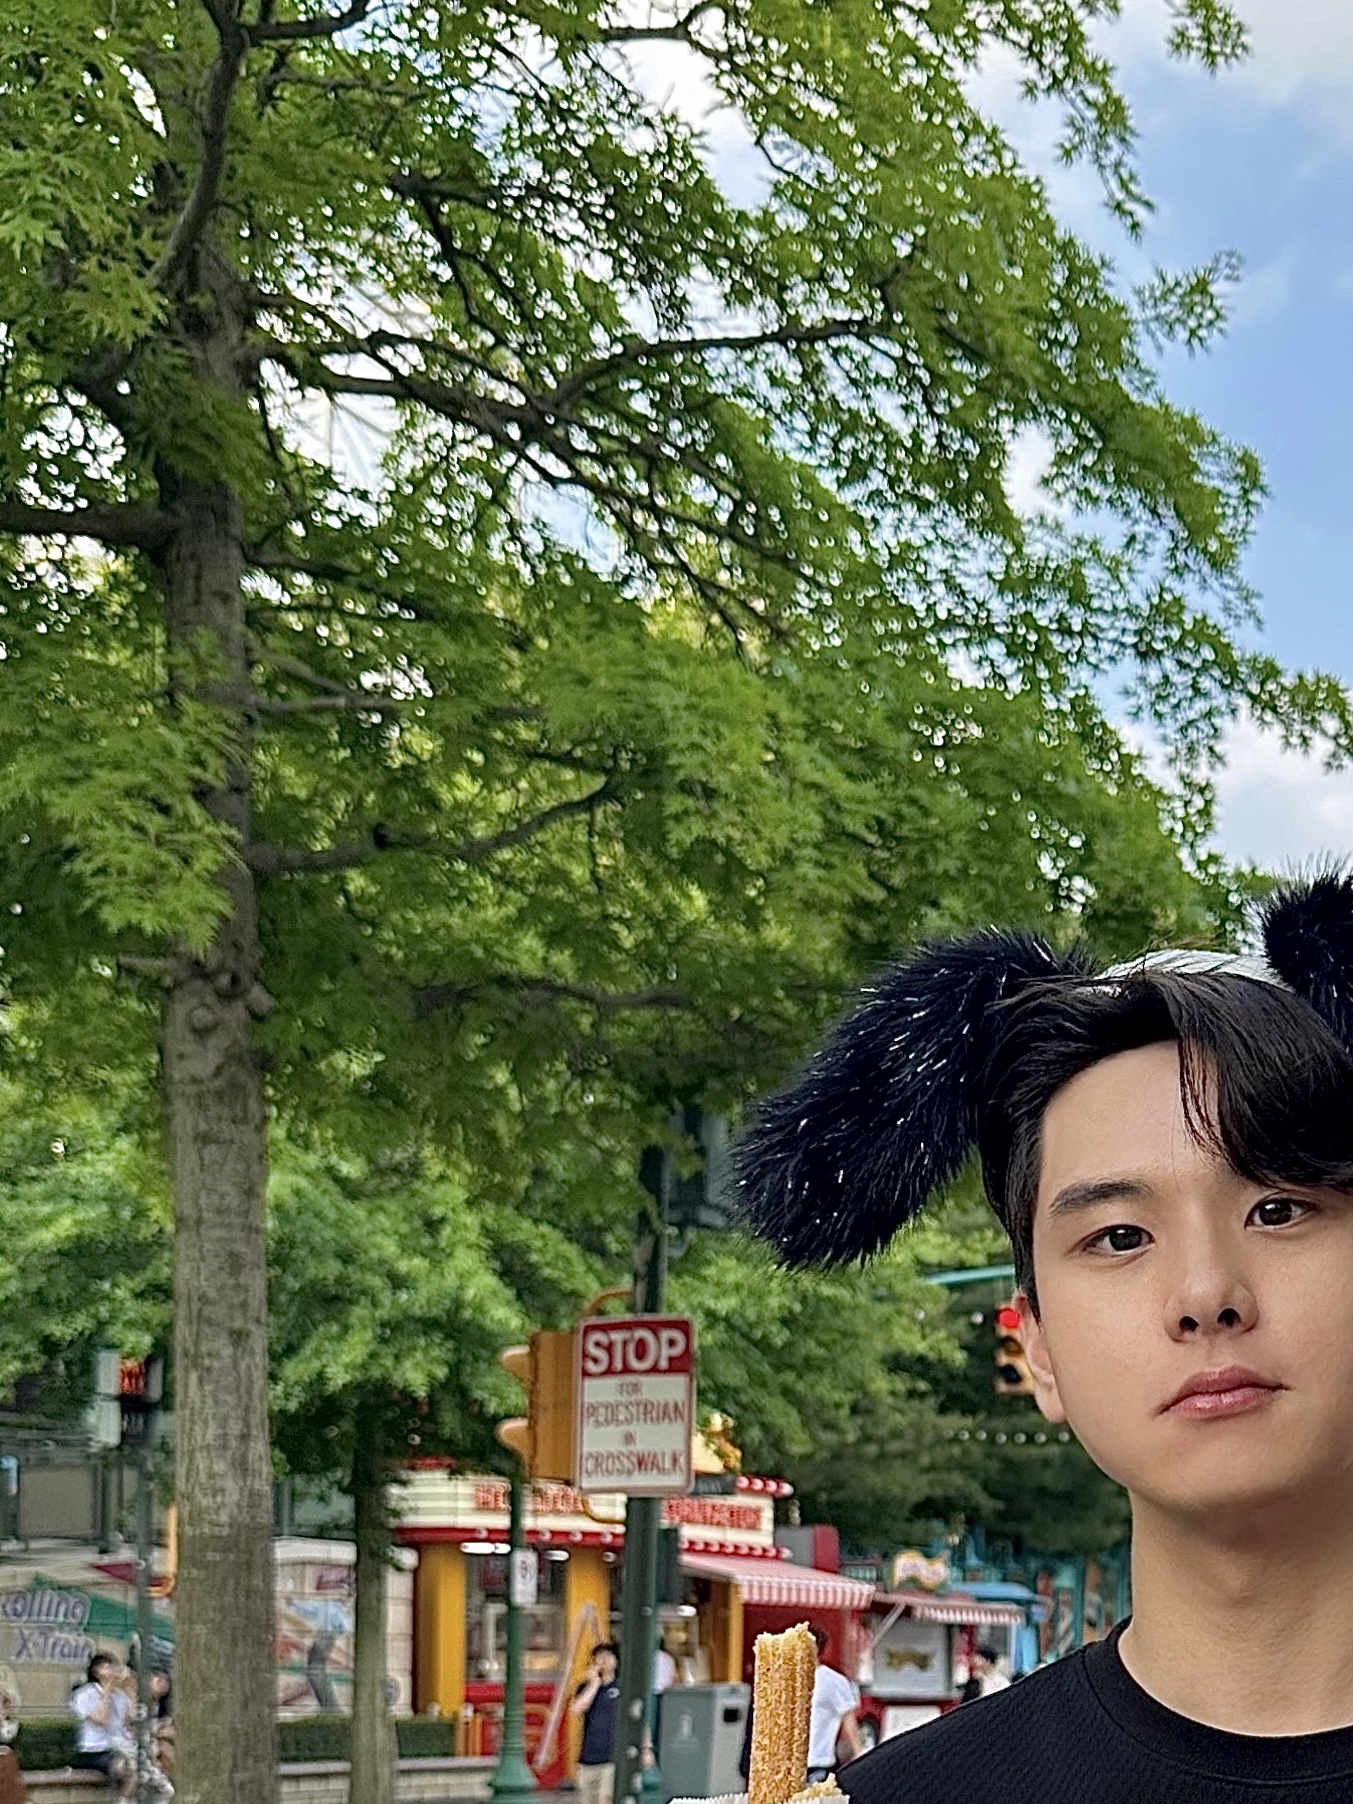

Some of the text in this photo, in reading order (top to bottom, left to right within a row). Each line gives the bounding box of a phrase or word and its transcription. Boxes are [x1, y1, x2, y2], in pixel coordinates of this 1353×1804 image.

[583, 1327, 687, 1375] STOP
[585, 1399, 686, 1428] PEDESTRIAN
[584, 1450, 685, 1478] CROSSWALK
